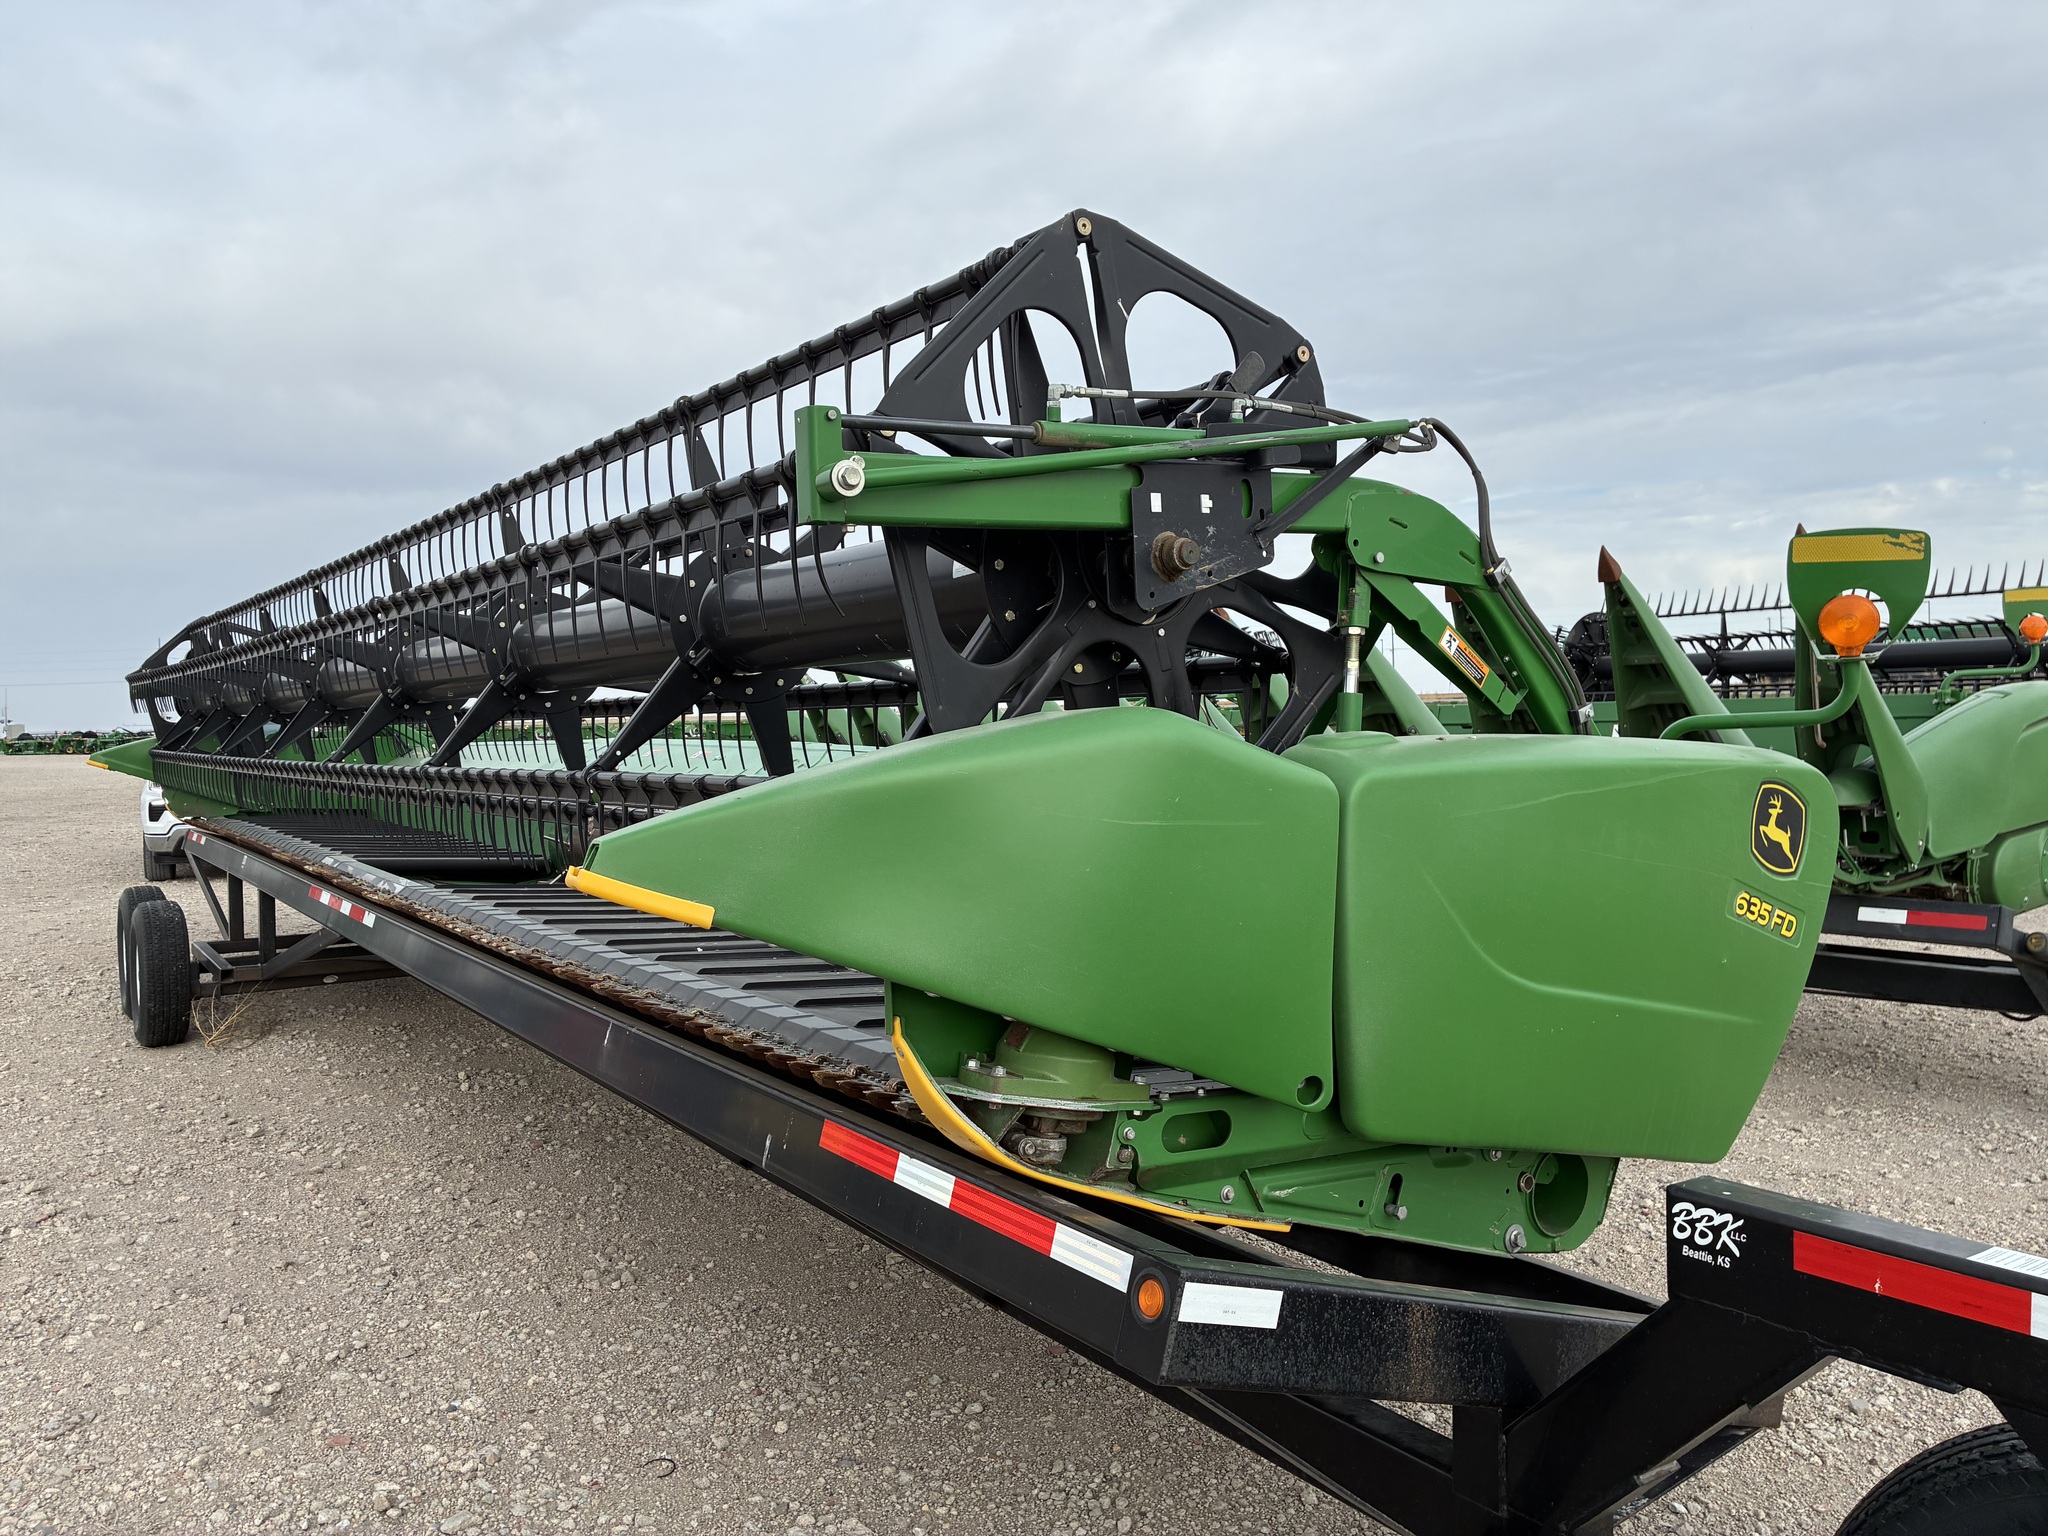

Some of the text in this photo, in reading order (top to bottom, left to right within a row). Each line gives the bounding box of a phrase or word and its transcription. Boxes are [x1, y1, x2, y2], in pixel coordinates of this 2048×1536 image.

[1735, 891, 1797, 939] 635FD
[1671, 1202, 1747, 1258] BBK LLC
[1682, 1244, 1731, 1269] Beattie, KS
